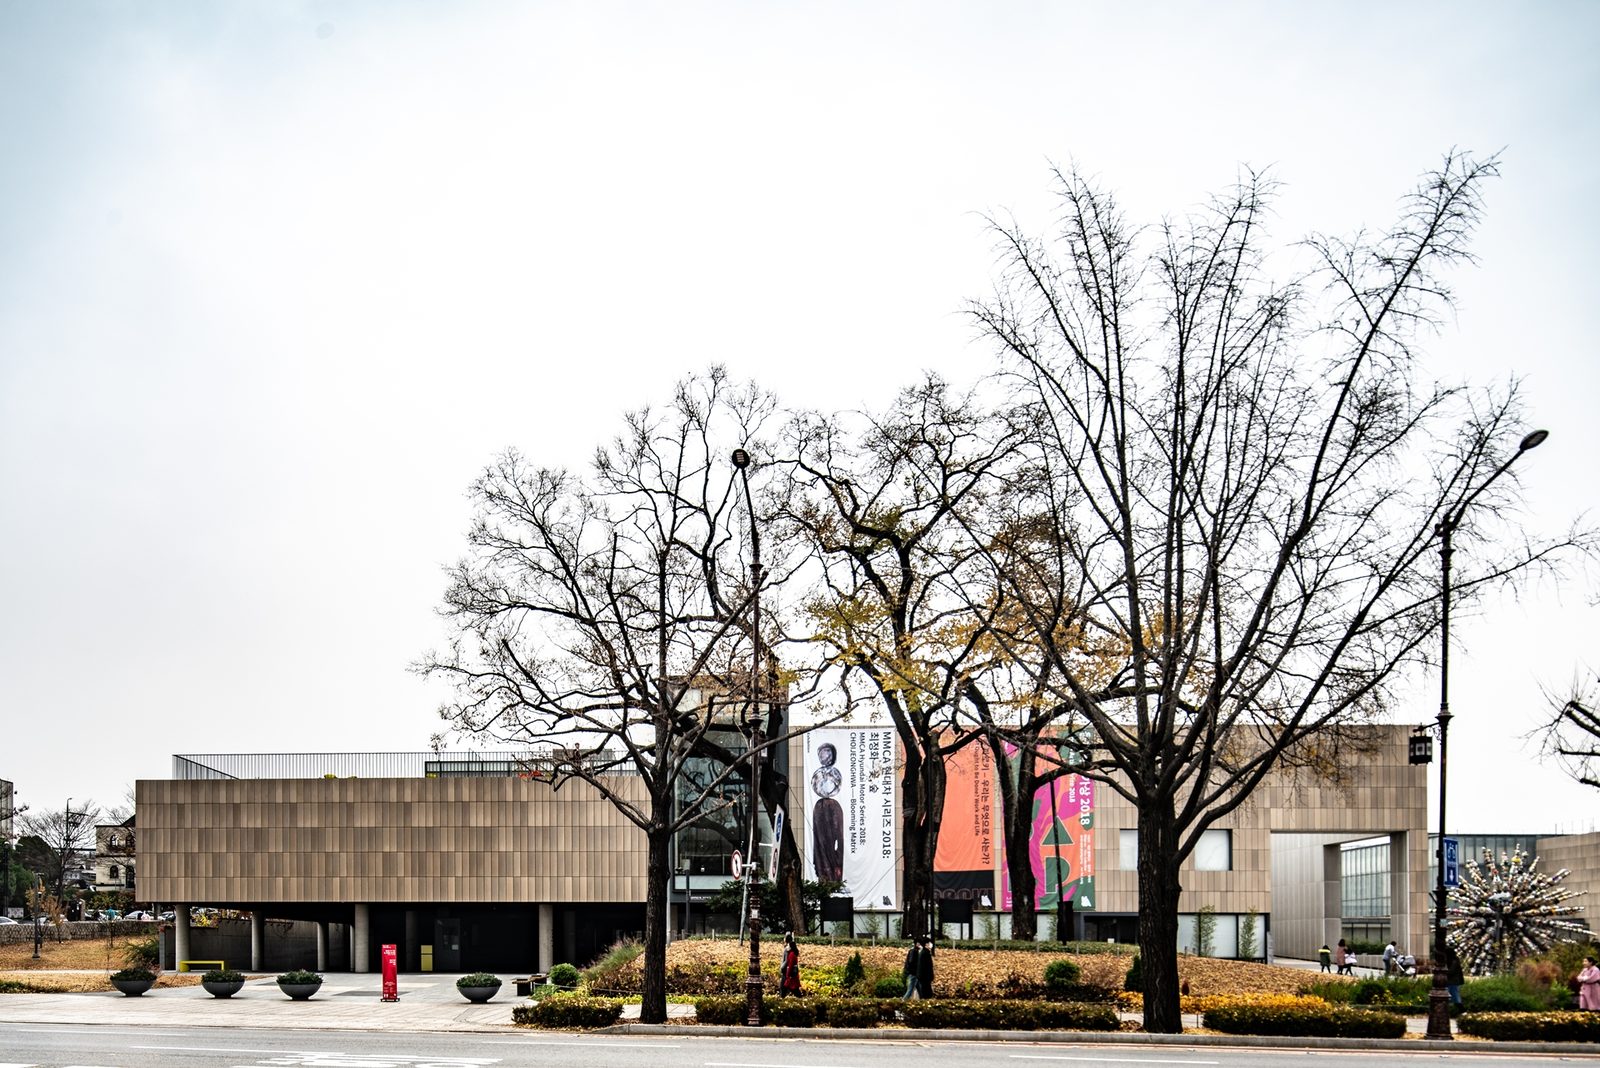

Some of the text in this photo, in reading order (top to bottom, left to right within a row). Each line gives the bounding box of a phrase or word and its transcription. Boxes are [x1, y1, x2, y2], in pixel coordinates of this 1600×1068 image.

[869, 784, 879, 793] 숲
[882, 732, 892, 858] MMCA 현대차 시리즈 2018:
[981, 780, 990, 802] 우리는
[981, 804, 989, 835] 무엇으로
[1080, 798, 1089, 825] 2018
[981, 837, 990, 864] 사는가?
